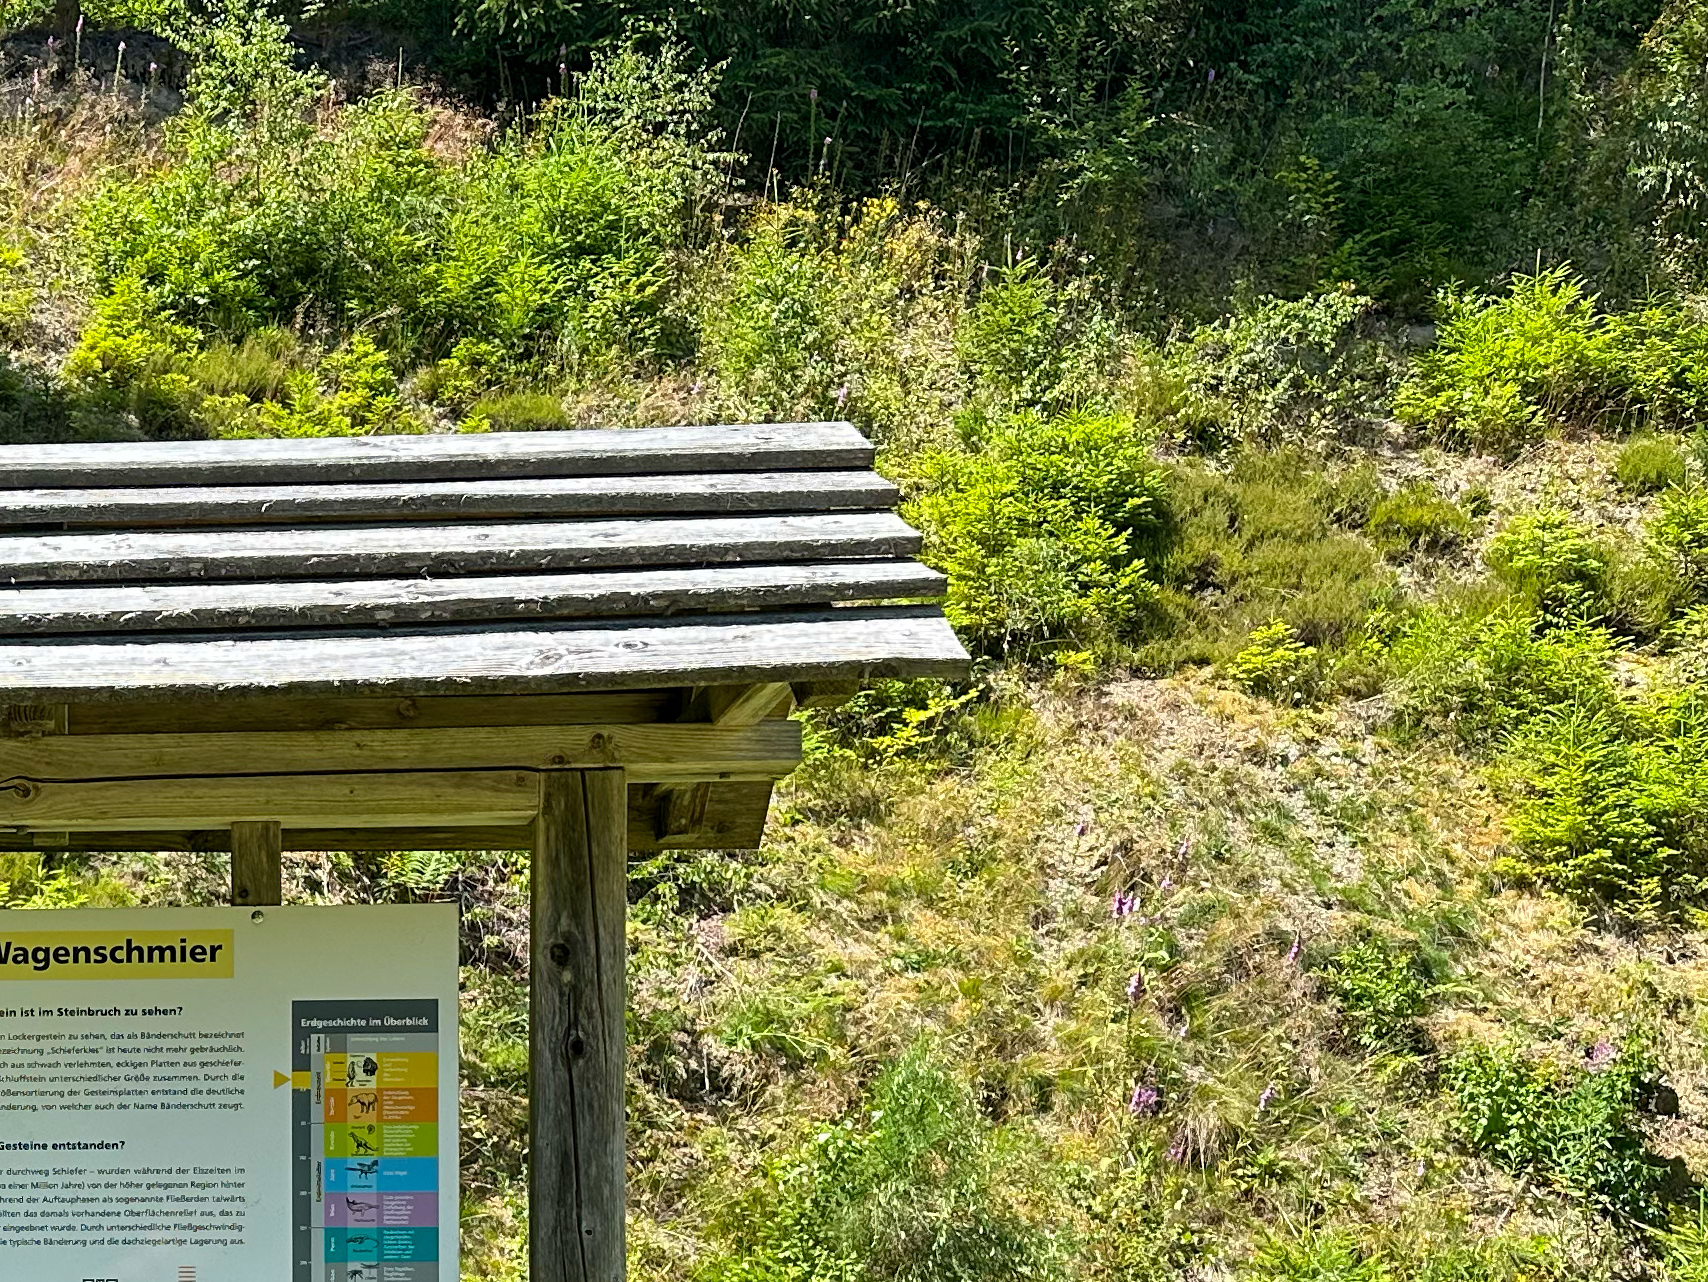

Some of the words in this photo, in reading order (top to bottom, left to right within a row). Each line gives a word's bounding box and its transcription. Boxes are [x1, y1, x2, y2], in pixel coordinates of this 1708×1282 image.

[21, 1008, 35, 1017] ist
[39, 1008, 53, 1016] im
[57, 1007, 121, 1017] Steinbruch
[142, 1006, 182, 1016] sehen?
[301, 1018, 366, 1028] Erdgeschichte
[369, 1018, 381, 1026] im
[384, 1016, 428, 1025] Überblick
[52, 1141, 125, 1150] entstanden?
